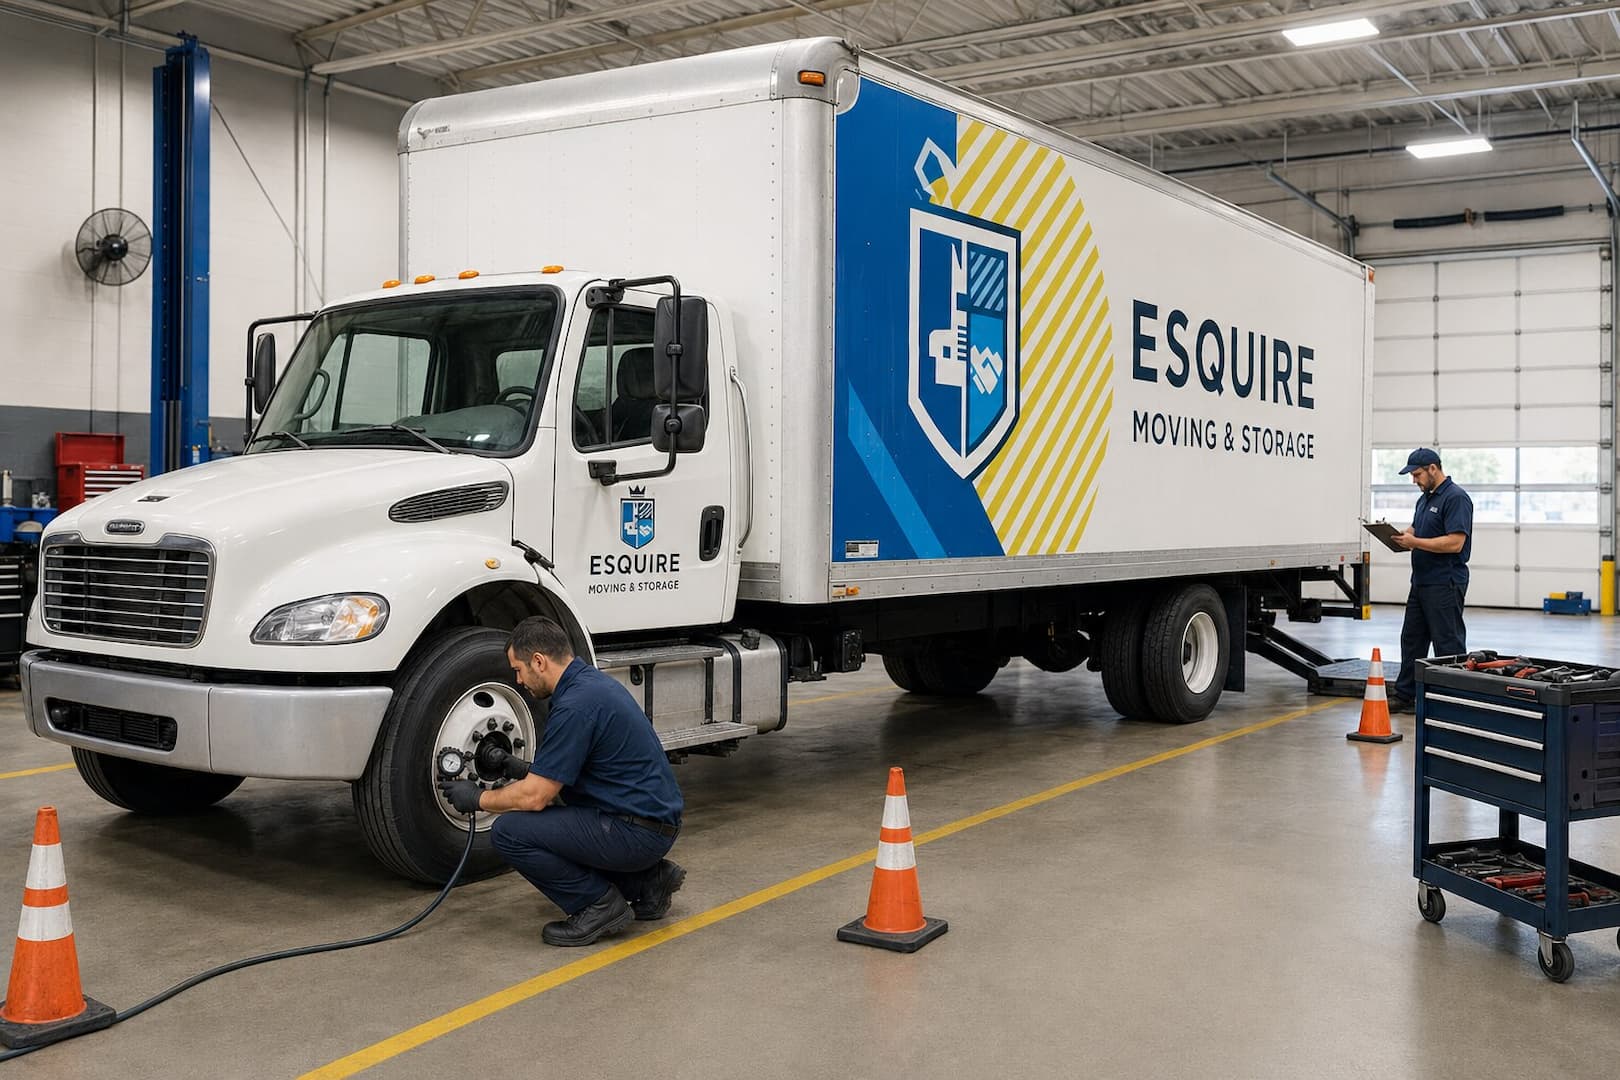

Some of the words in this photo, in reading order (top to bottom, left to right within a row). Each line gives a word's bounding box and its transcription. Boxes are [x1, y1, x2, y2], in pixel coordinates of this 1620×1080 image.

[1133, 299, 1314, 409] ESQUIRE
[1133, 410, 1217, 450] MOVING
[1224, 422, 1234, 451] &
[1242, 424, 1314, 459] STORAGE
[590, 553, 680, 575] ESQUIRE
[588, 583, 626, 594] MOVING
[629, 582, 635, 592] &
[638, 580, 679, 591] STORAGE
